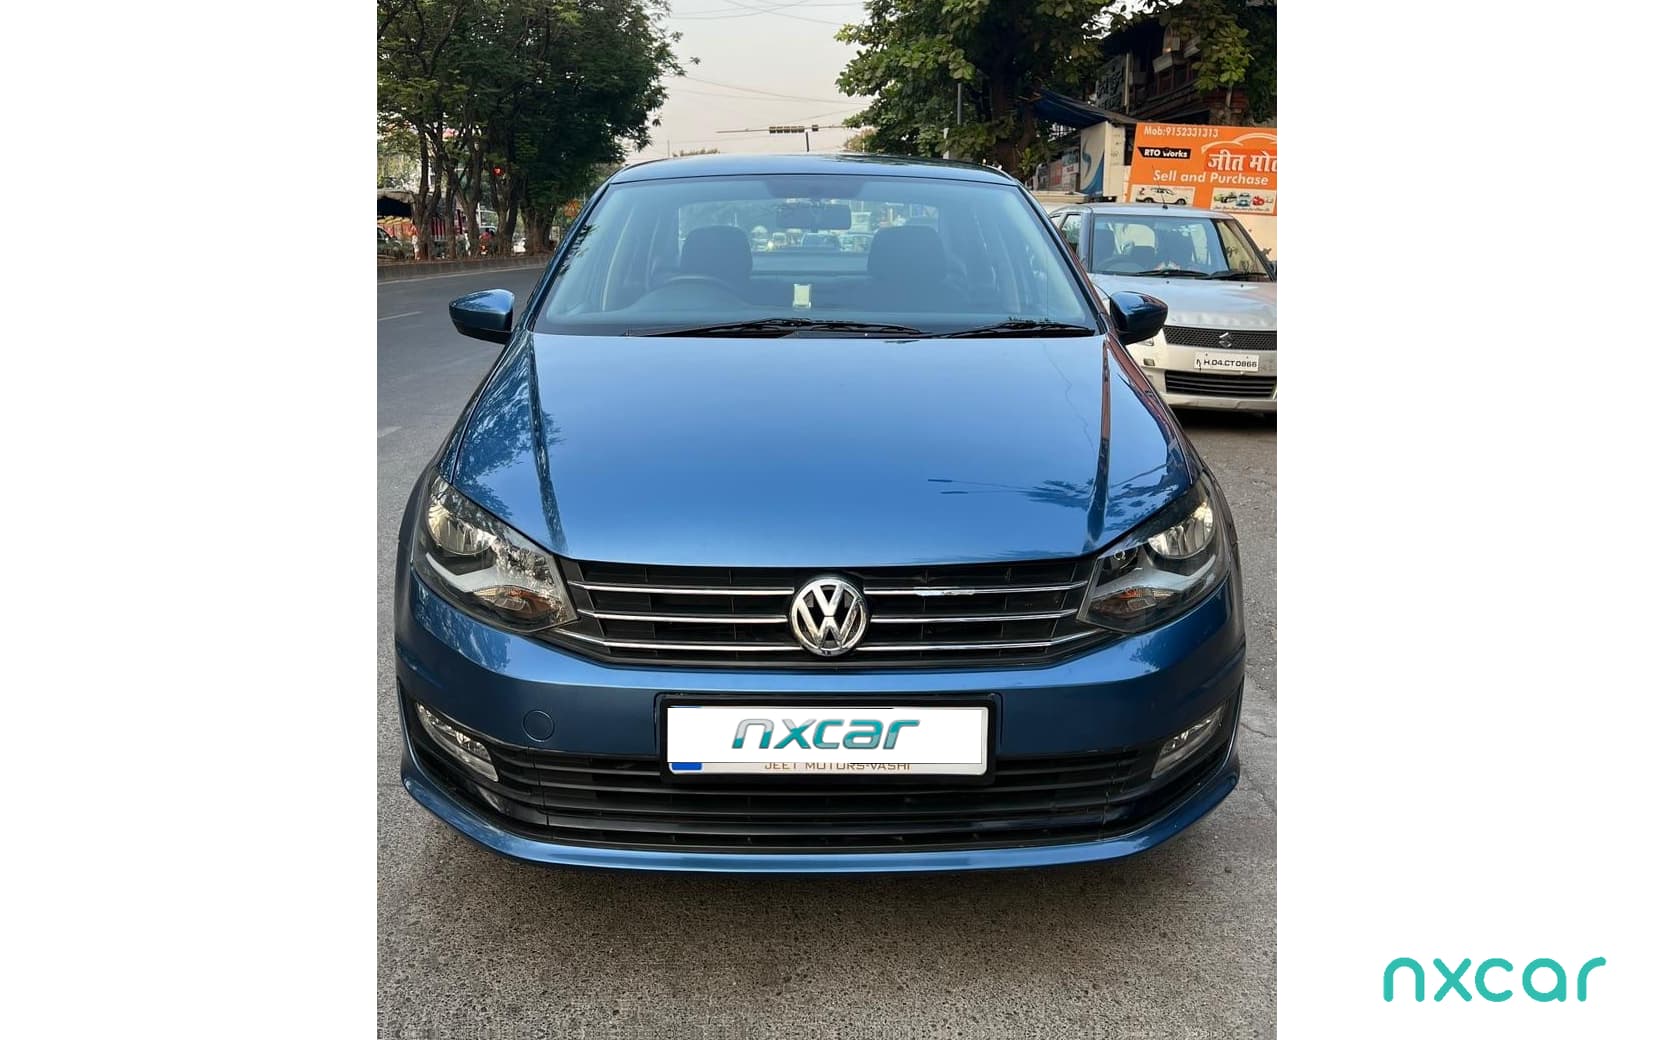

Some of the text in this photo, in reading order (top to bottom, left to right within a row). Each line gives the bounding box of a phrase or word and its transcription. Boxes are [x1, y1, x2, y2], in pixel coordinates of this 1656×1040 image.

[1144, 126, 1218, 138] Mob:9152331313
[1208, 149, 1246, 171] जीत
[1153, 170, 1269, 185] Sell and Purchase
